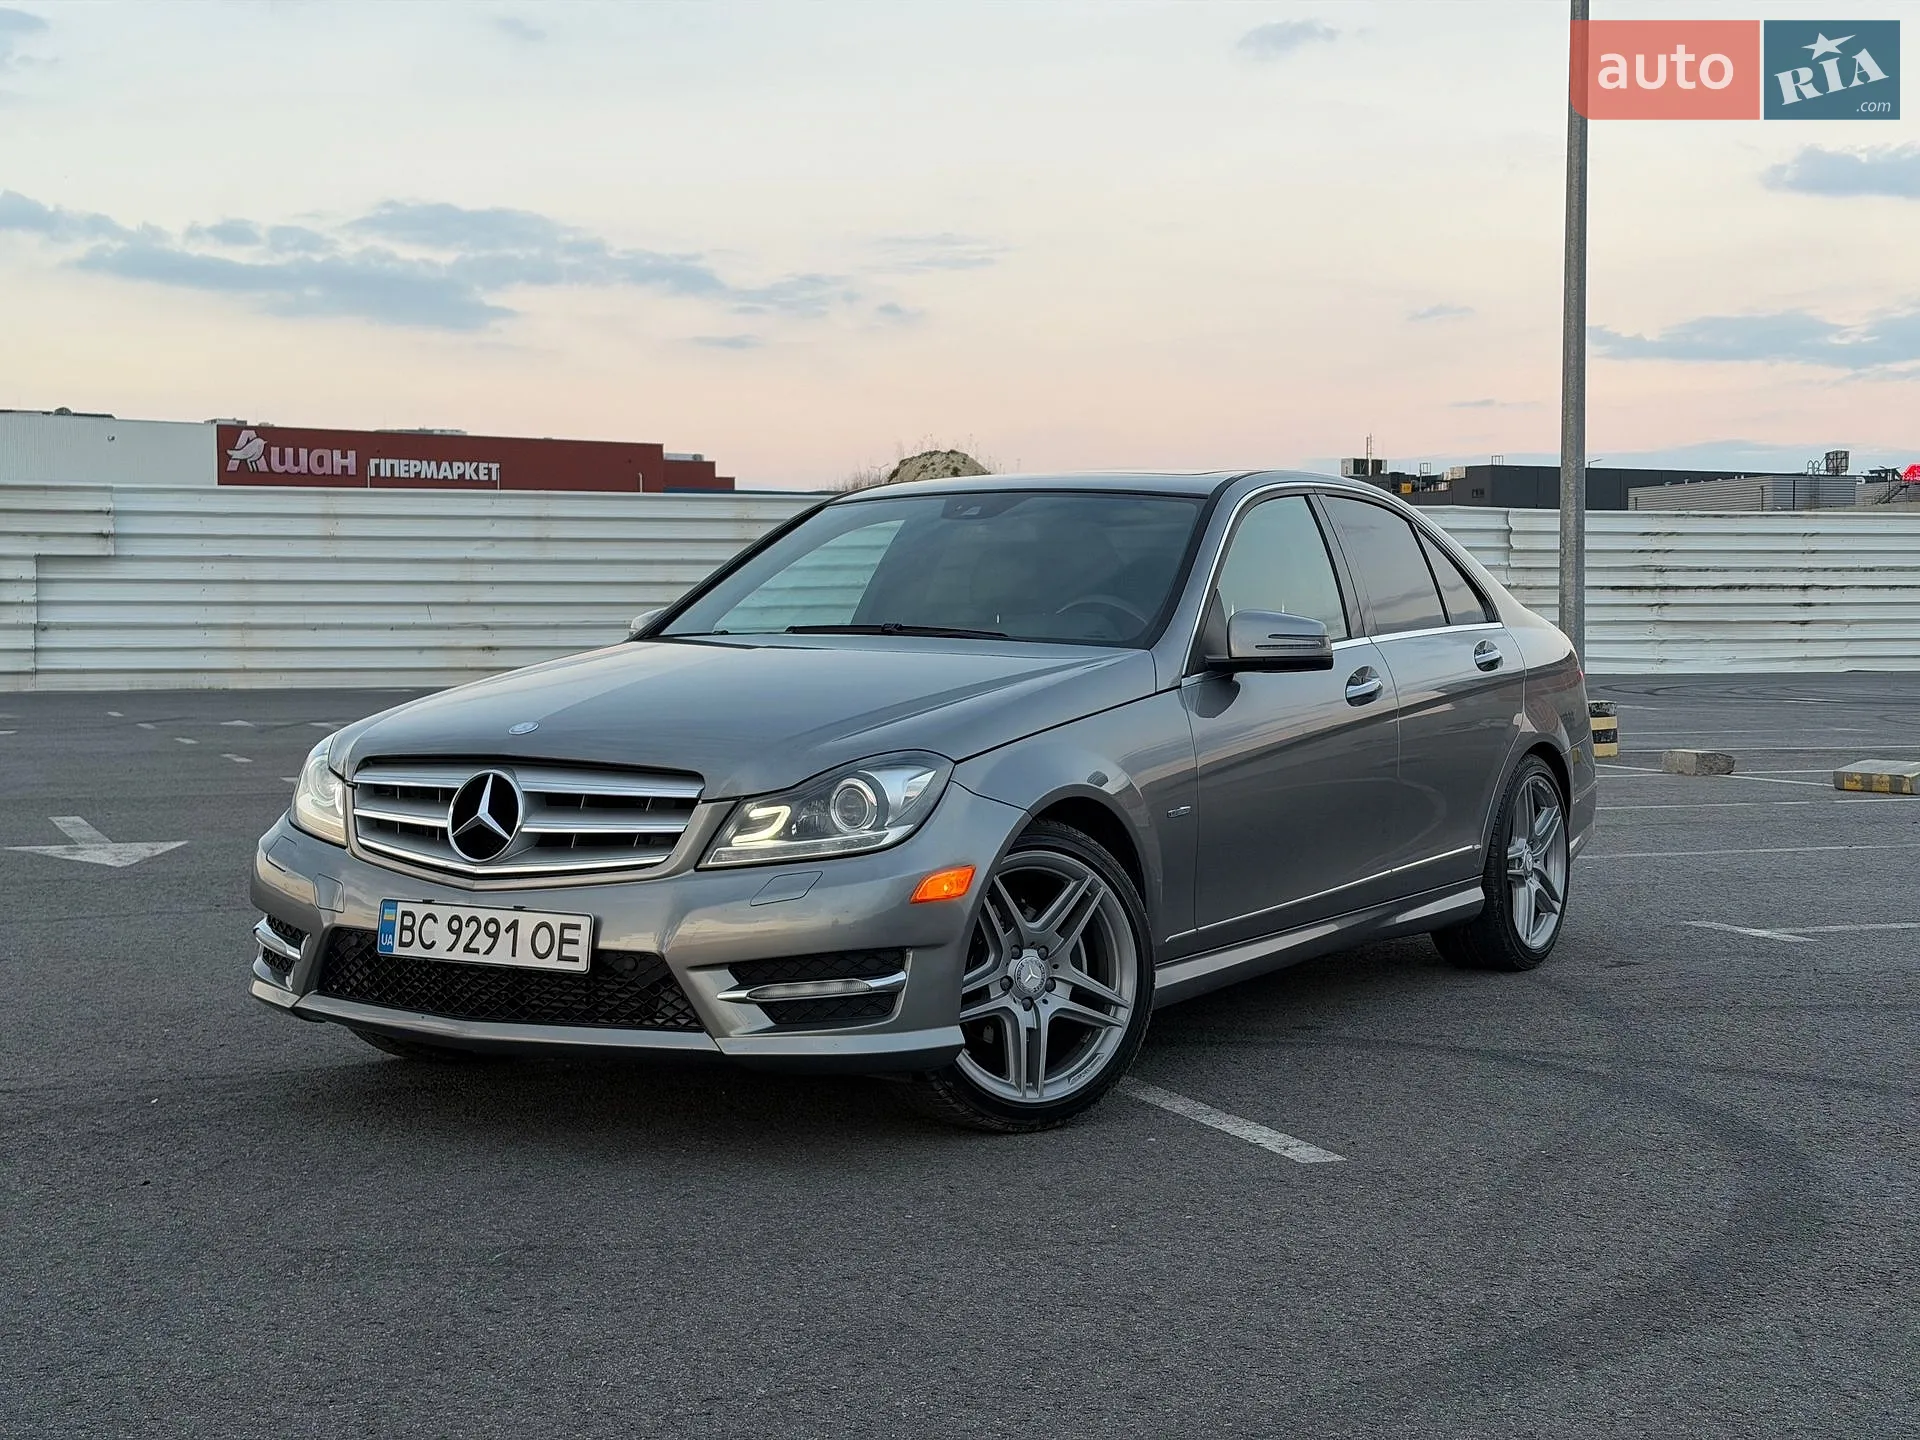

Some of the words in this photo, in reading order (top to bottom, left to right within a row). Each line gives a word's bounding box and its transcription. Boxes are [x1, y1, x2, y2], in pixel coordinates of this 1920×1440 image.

[226, 429, 357, 476] Ашан
[369, 458, 500, 481] ГІПЕРМАРКЕТ
[381, 933, 393, 946] UA
[398, 910, 439, 950] BC
[446, 914, 519, 958] 9291
[530, 920, 582, 963] OE
